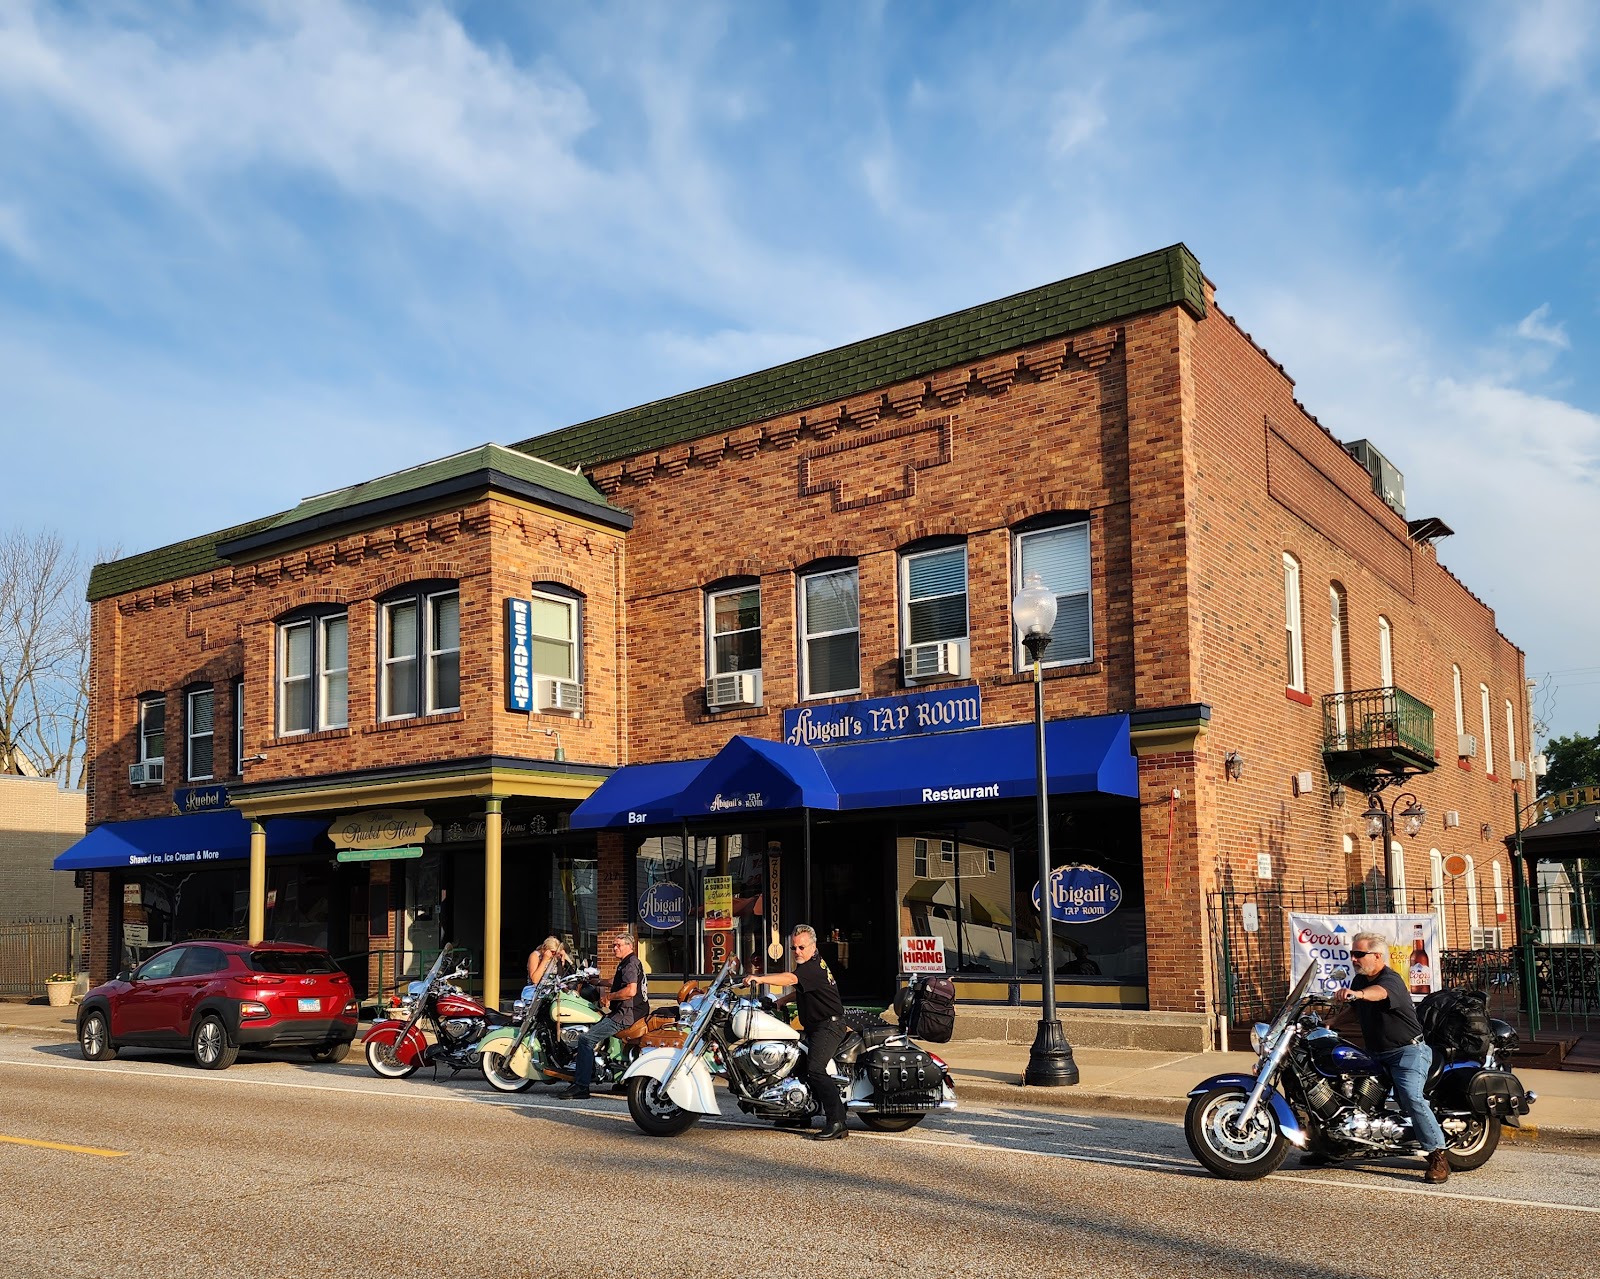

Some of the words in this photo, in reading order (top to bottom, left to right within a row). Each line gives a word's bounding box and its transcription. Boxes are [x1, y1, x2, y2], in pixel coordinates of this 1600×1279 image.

[513, 600, 530, 708] RESTAURANT
[786, 708, 862, 746] Abigail's
[868, 705, 910, 732] TAP
[915, 697, 978, 727] ROOM
[185, 788, 219, 812] Ruebel
[922, 783, 999, 802] Restaurant
[1537, 784, 1600, 818] RUE
[709, 793, 742, 812] Abigail's
[745, 799, 763, 808] ROOM
[628, 812, 647, 824] Bar
[341, 823, 381, 843] Ruebel
[383, 820, 417, 841] Hotel
[129, 853, 152, 865] Shaved
[152, 853, 164, 863] Ice,
[164, 852, 174, 862] Ice
[174, 851, 195, 861] Cream
[196, 850, 202, 860] &
[202, 848, 220, 859] More
[704, 877, 731, 885] SATURDAY
[710, 883, 731, 891] SUNDAY
[640, 887, 685, 919] Abigail'
[1063, 906, 1080, 916] TAP
[1082, 906, 1105, 915] ROOM
[907, 939, 936, 951] NOW
[1298, 928, 1341, 946] Coors
[903, 951, 943, 964] HIRING
[1317, 978, 1351, 991] TOW
